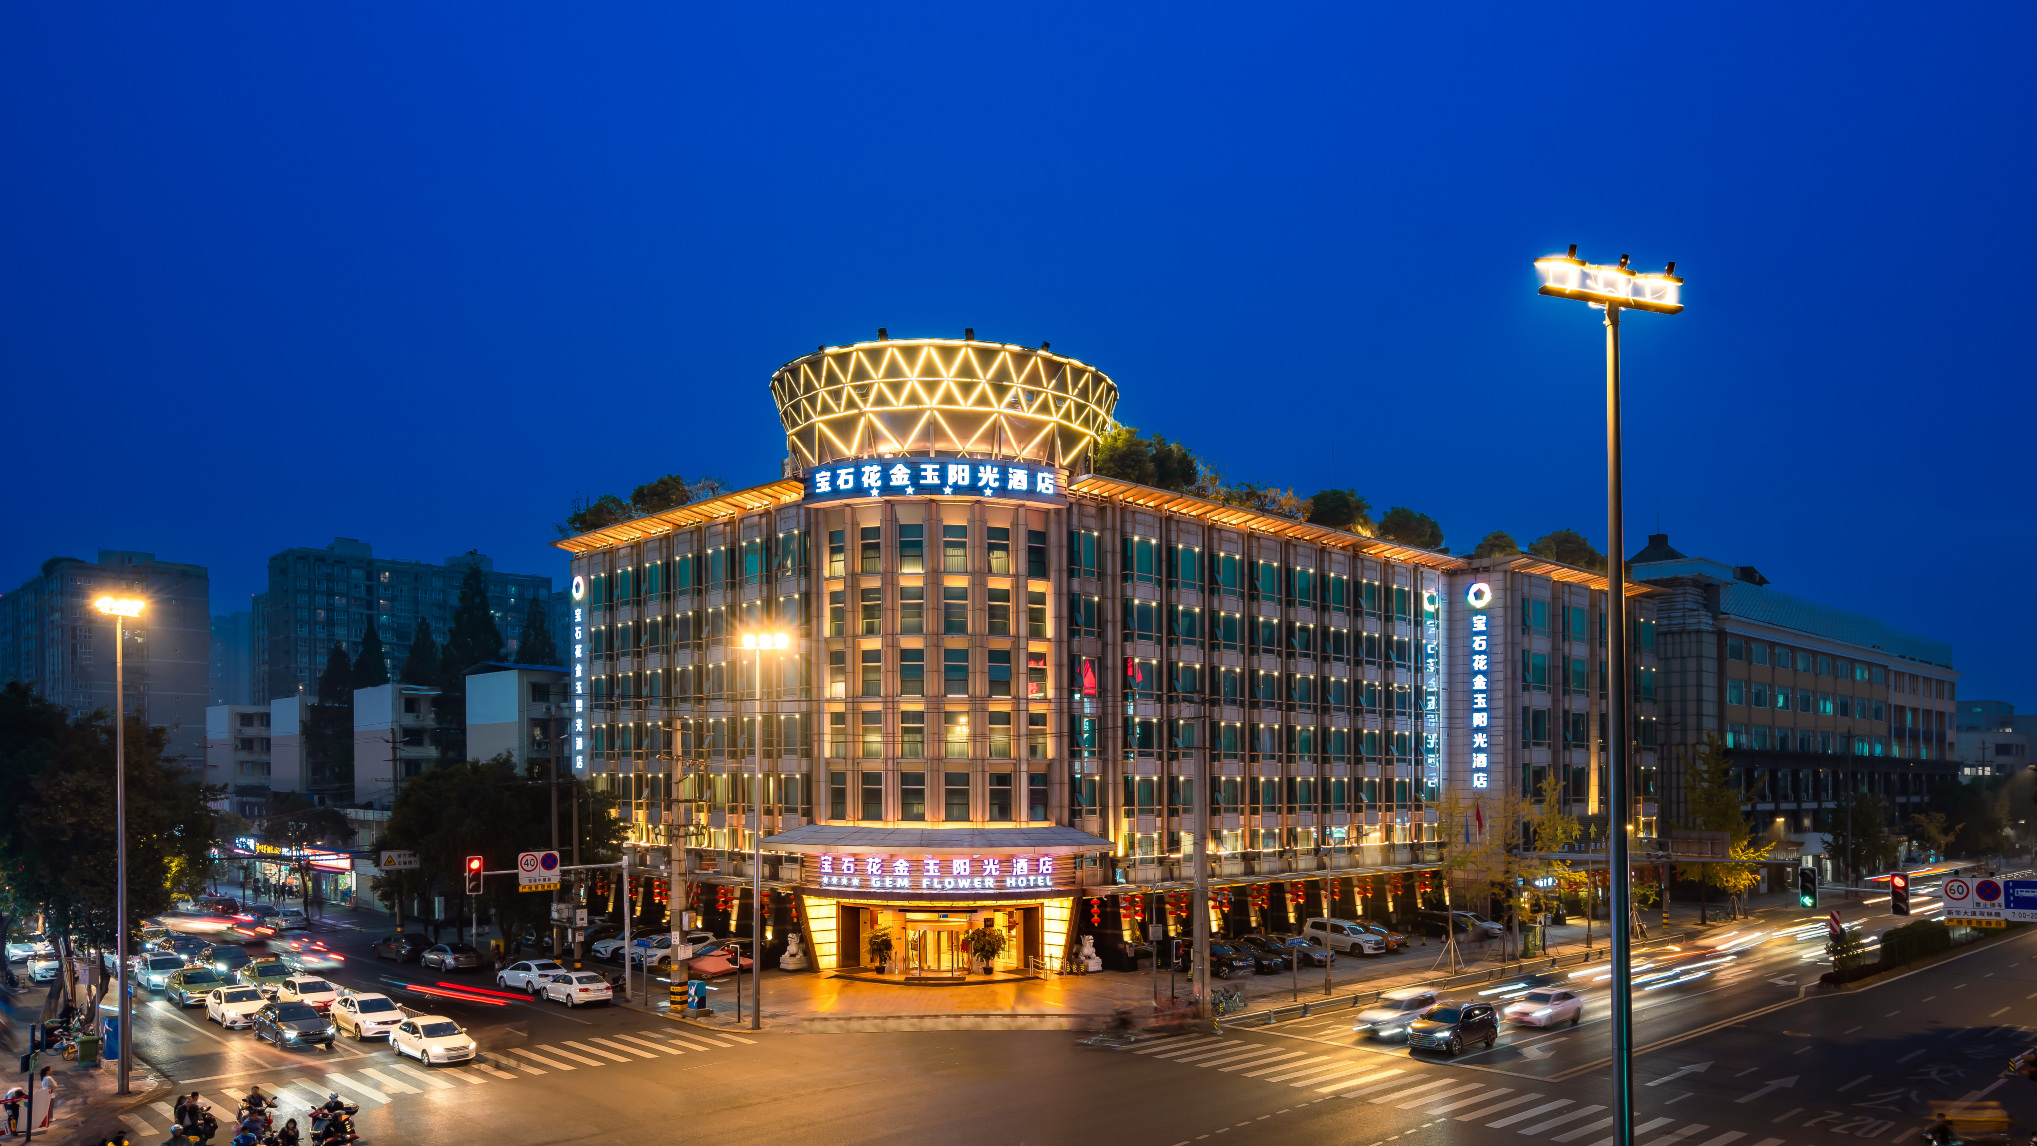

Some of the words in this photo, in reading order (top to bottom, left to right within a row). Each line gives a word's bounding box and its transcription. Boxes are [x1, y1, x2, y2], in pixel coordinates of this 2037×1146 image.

[815, 463, 1055, 494] 宝石花金玉阳光酒店
[574, 608, 584, 769] 宝石花金玉阳光酒店
[1472, 615, 1488, 789] 宝石花金玉阳光酒店
[523, 858, 536, 868] 40
[820, 855, 1053, 876] 宝石花金玉阳光酒店
[871, 876, 909, 888] GEM
[922, 877, 995, 889] FLOWER
[1006, 875, 1053, 888] HOTEL
[1948, 884, 1965, 895] 60
[1946, 909, 2002, 918] 新华大道双林路
